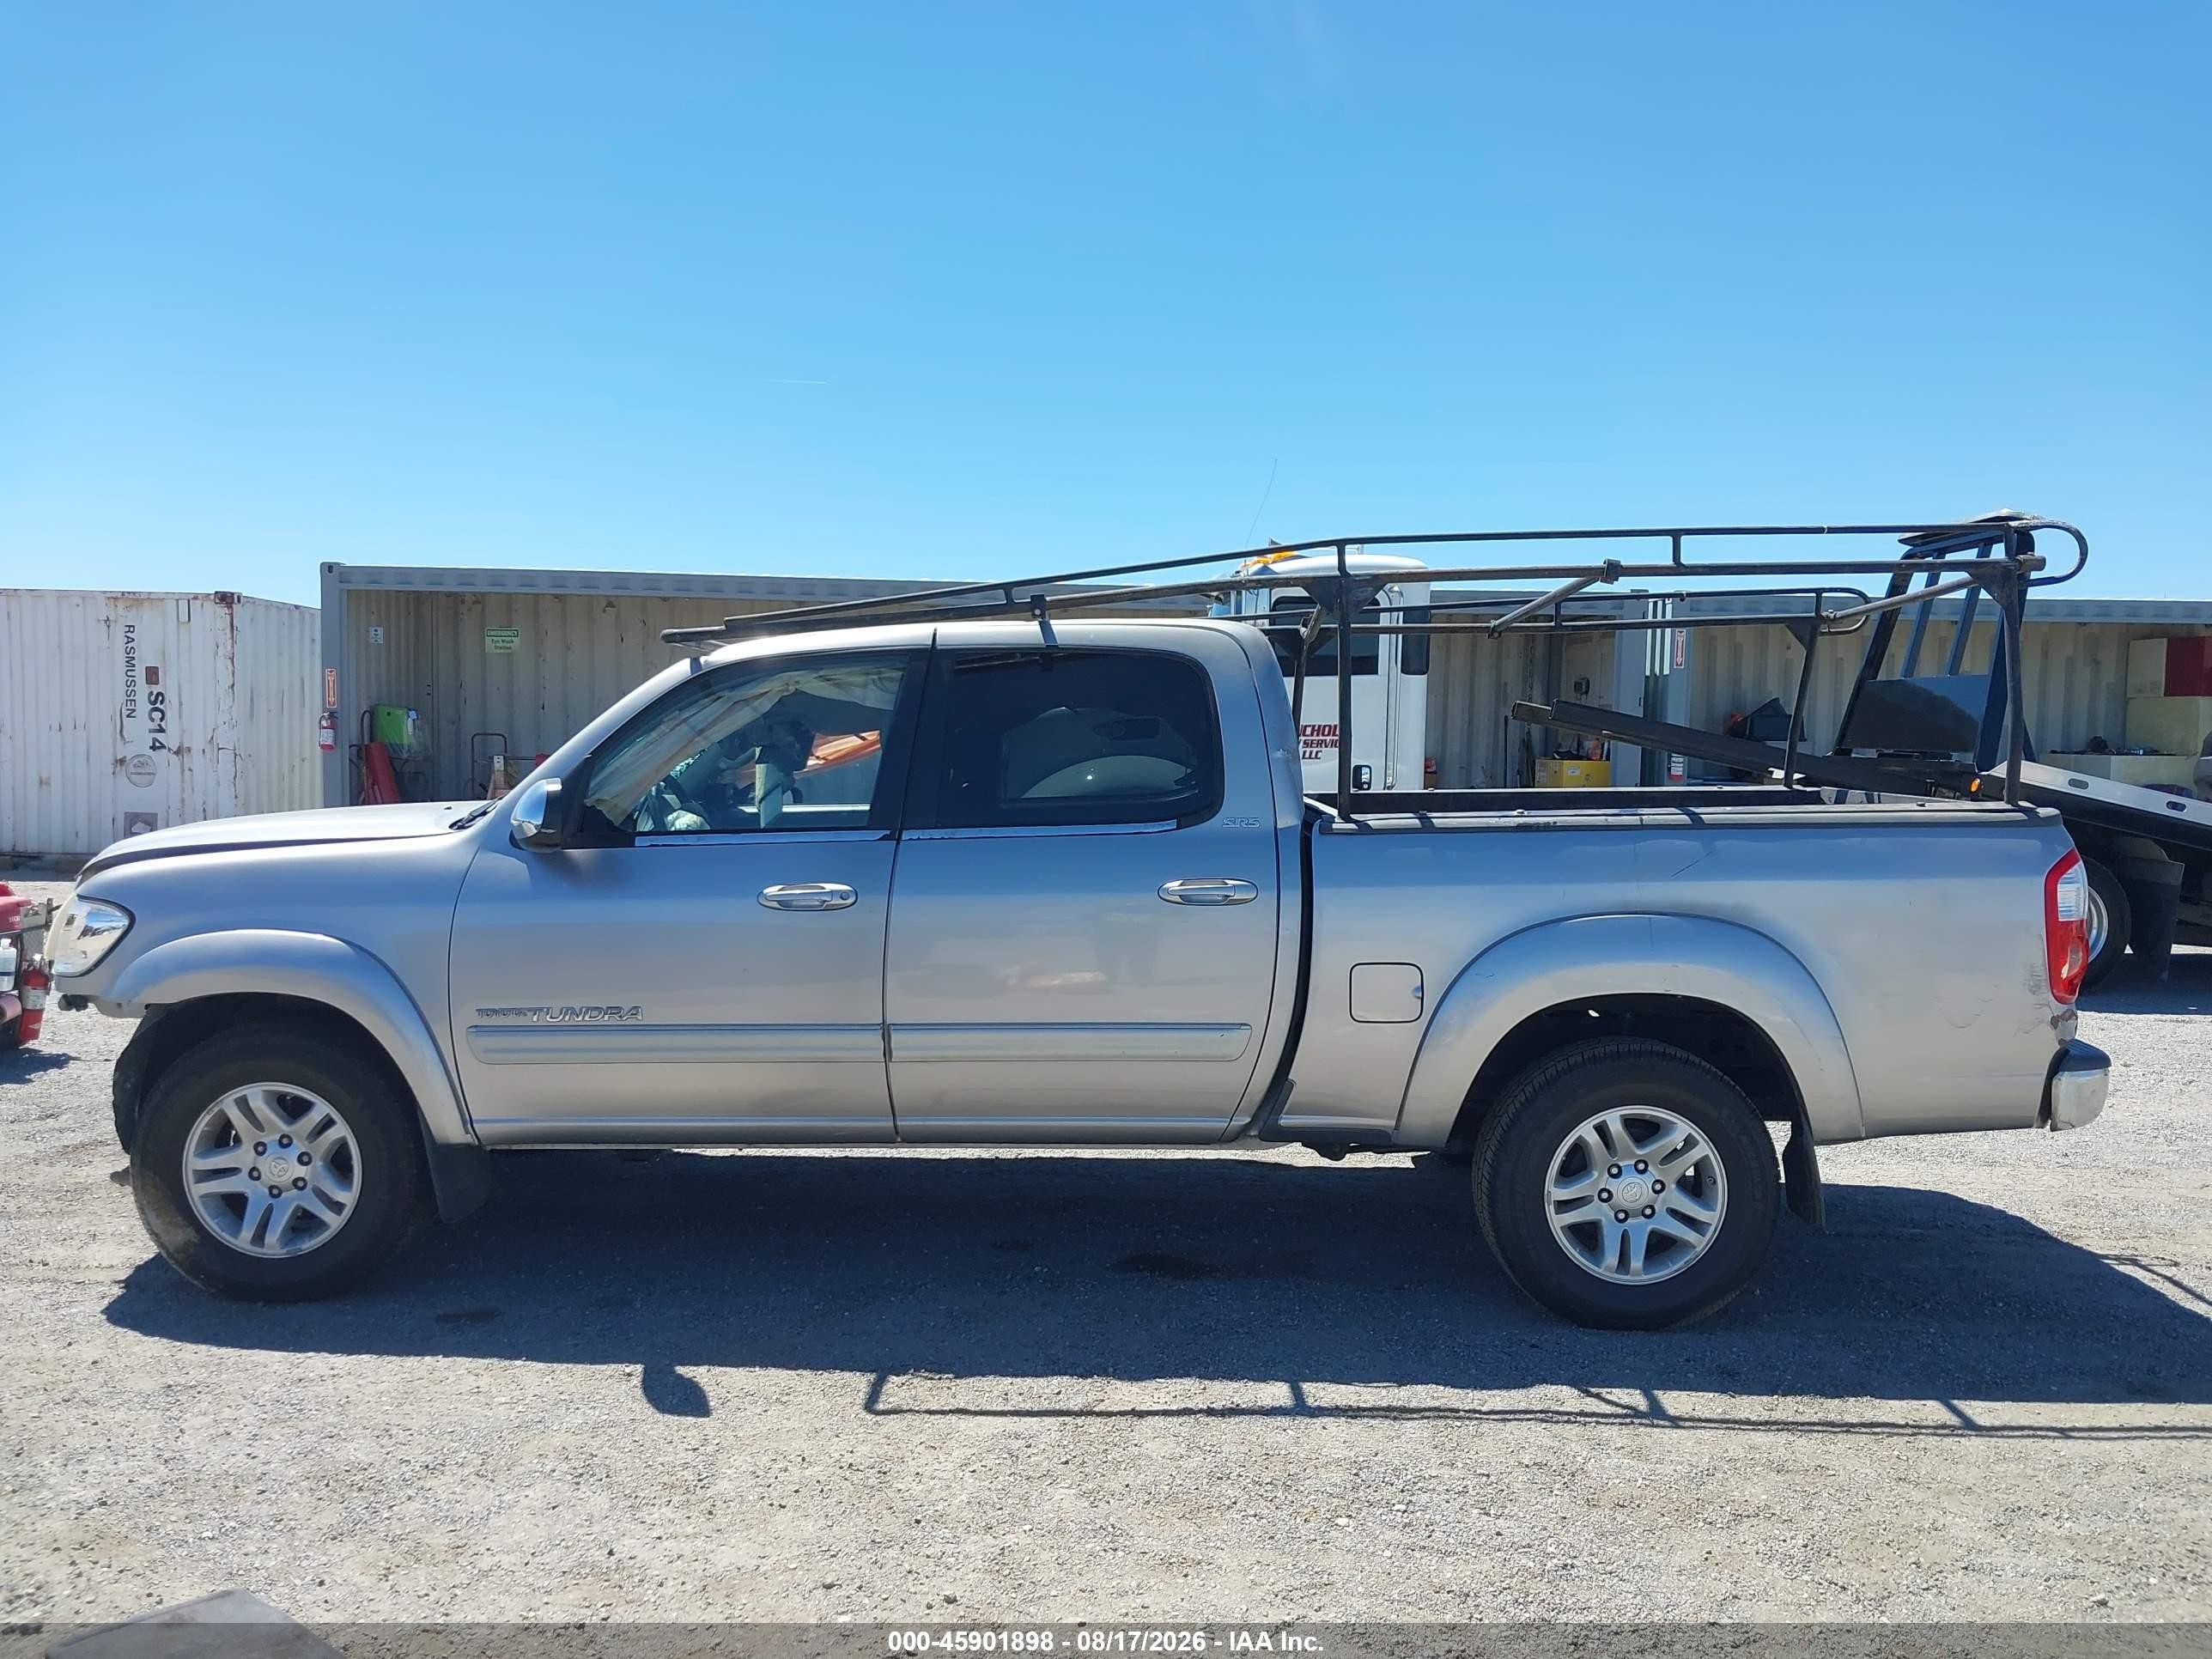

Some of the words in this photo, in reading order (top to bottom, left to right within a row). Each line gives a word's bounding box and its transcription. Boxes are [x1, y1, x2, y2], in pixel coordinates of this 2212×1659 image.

[125, 624, 137, 719] RASMUSSEN
[148, 690, 167, 752] SC14
[1302, 750, 1322, 760] LLC
[527, 1006, 644, 1022] TUNDRA
